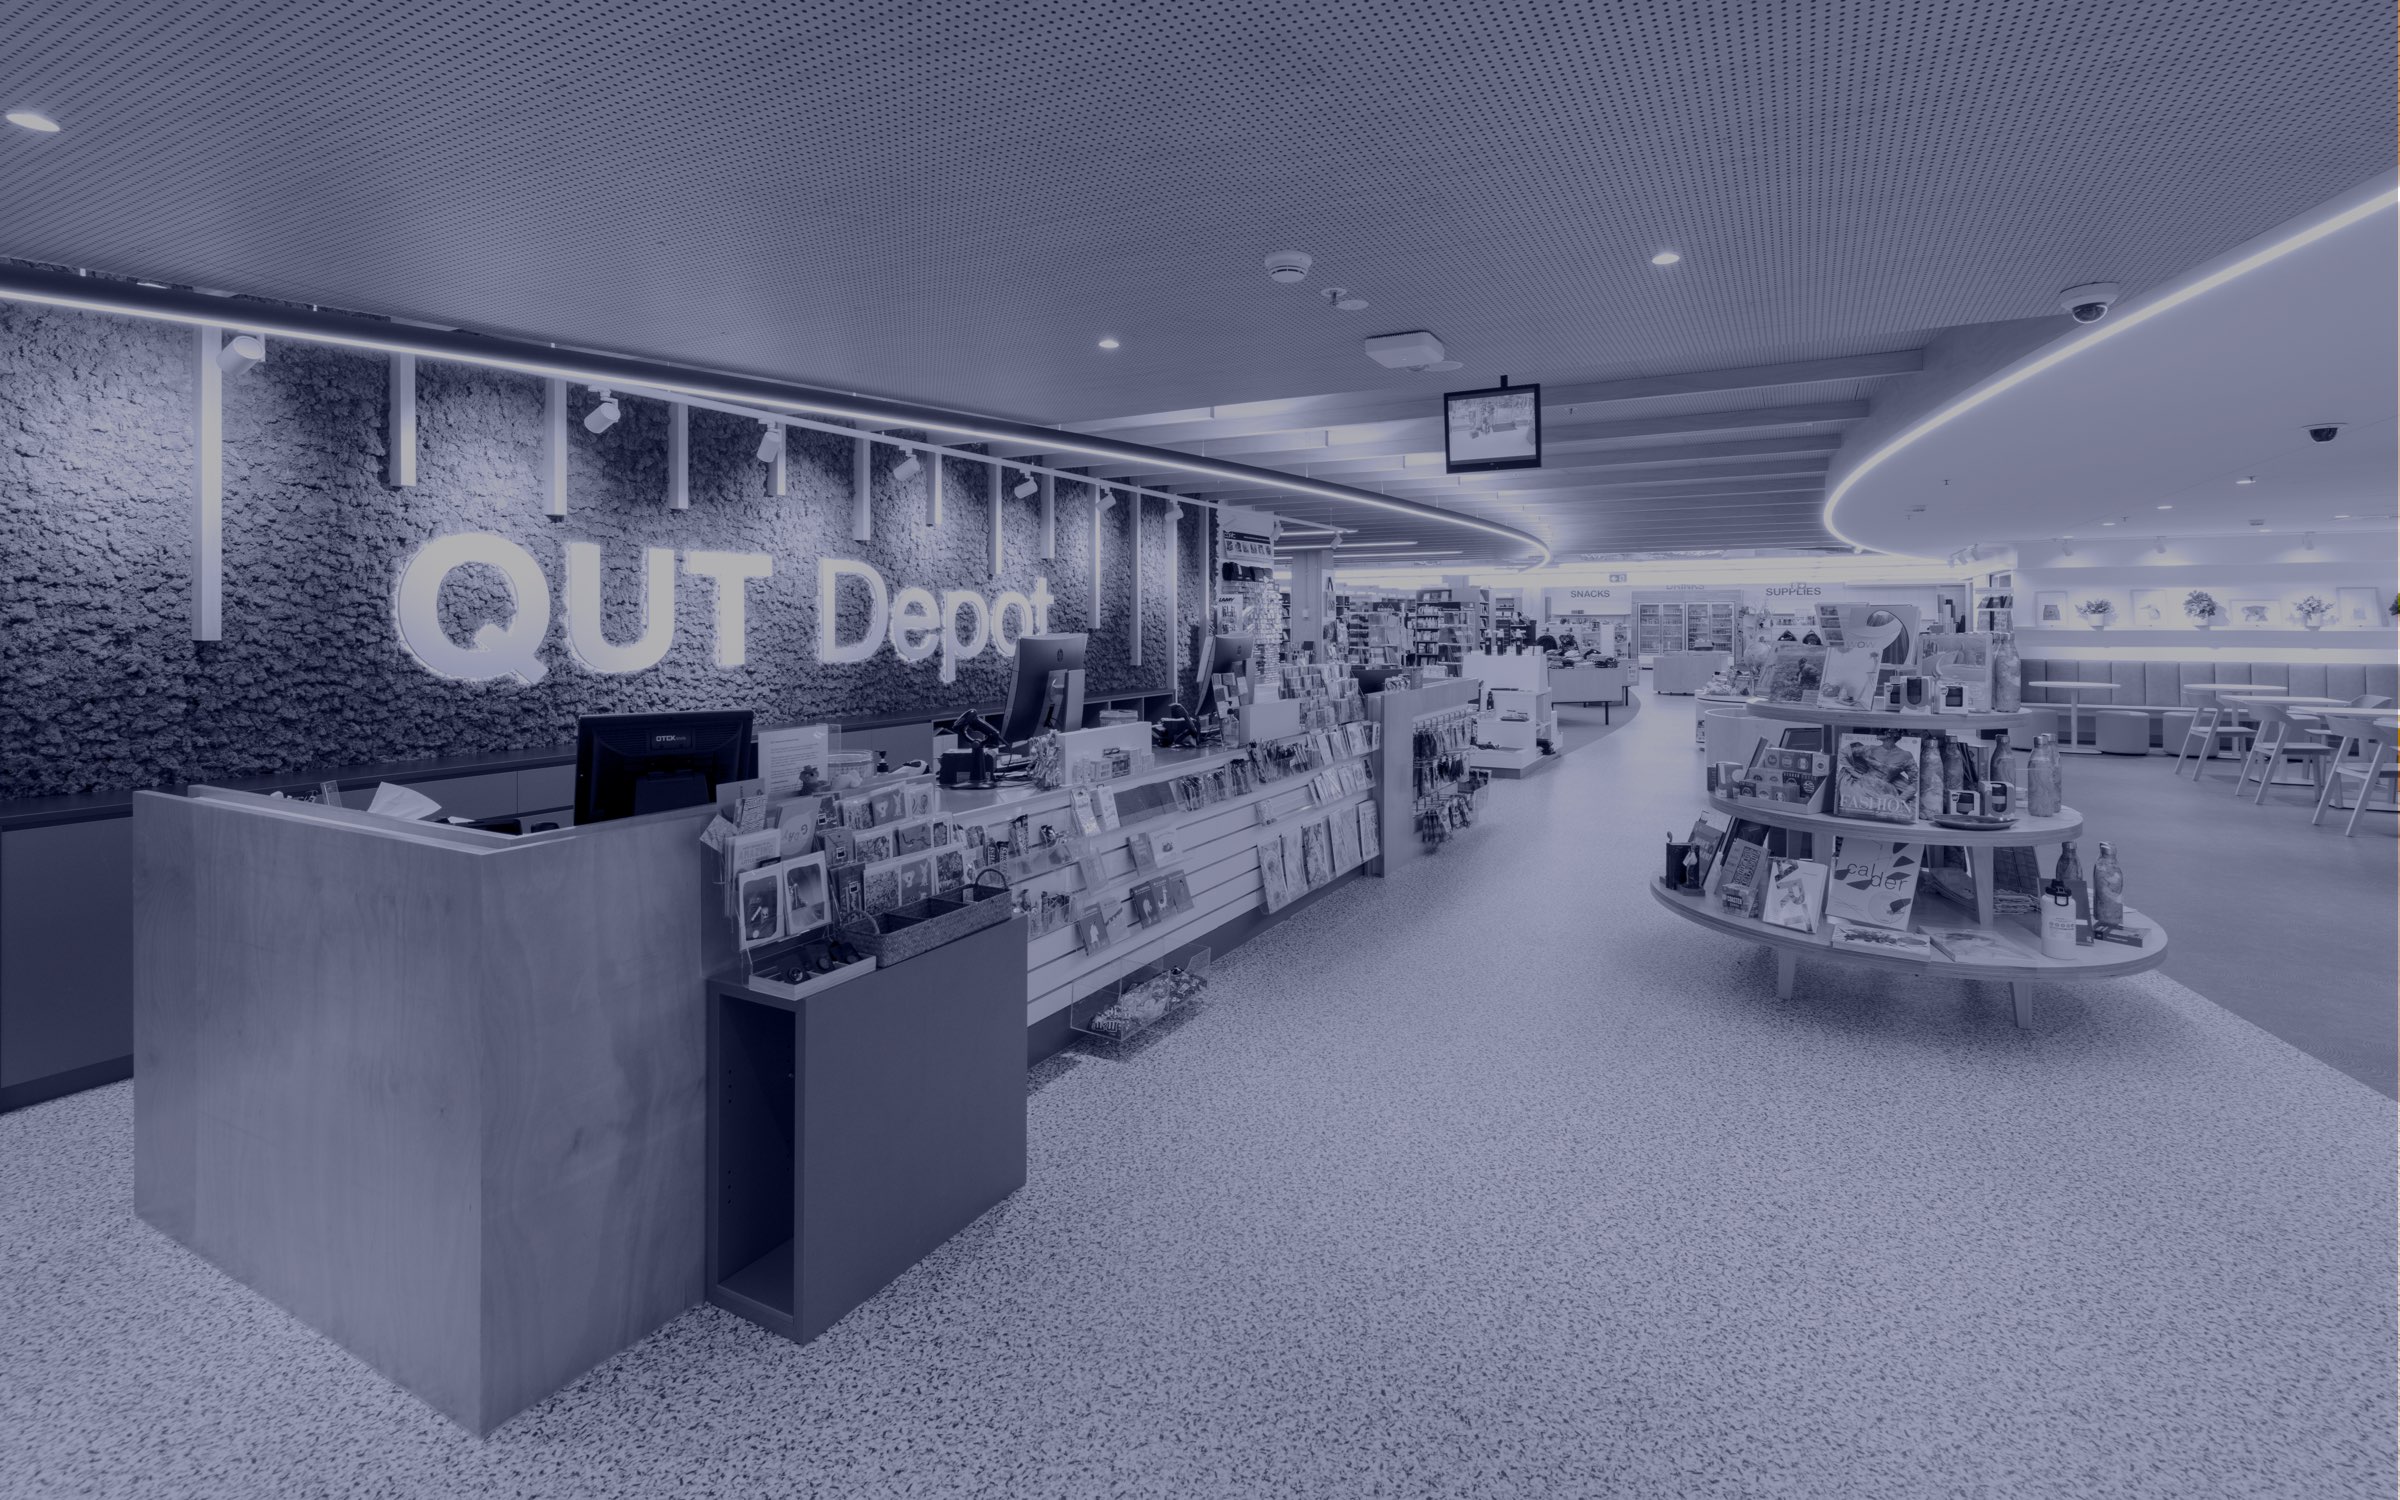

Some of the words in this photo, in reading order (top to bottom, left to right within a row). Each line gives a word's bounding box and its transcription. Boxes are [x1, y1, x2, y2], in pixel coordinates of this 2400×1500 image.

[1570, 590, 1611, 599] SNACKS
[1766, 587, 1822, 597] SUPPLIES
[397, 532, 774, 686] QUT
[817, 557, 1055, 684] Depot
[1839, 793, 1913, 815] FASHION
